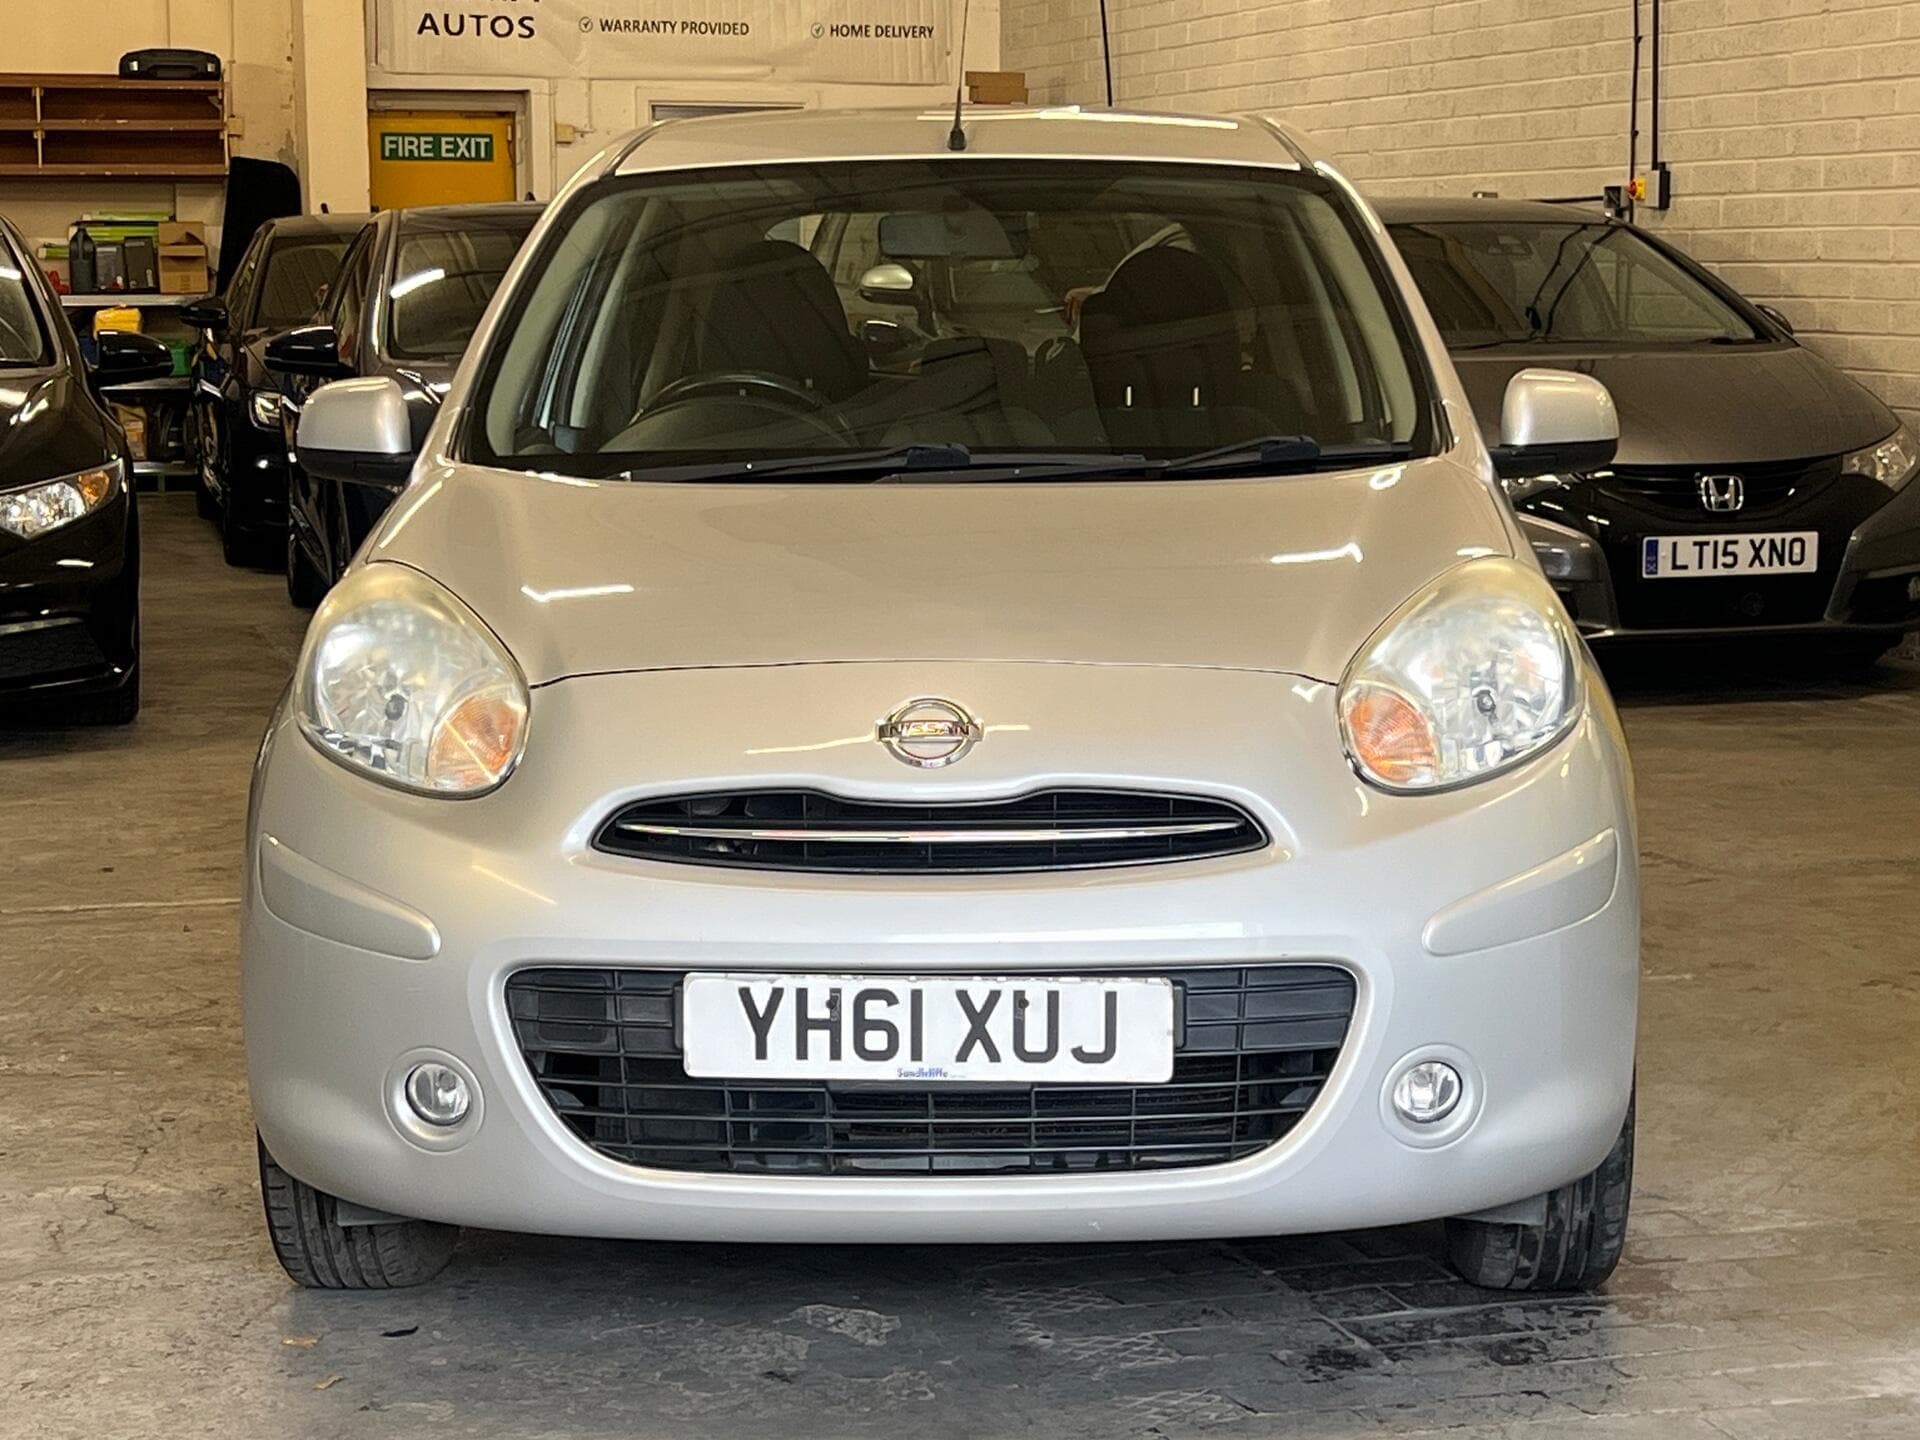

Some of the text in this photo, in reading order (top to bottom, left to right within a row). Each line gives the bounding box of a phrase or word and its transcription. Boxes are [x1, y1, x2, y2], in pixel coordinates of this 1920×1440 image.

[417, 12, 535, 39] AUTOS
[600, 18, 749, 36] WARRANTY PROVIDED
[830, 24, 934, 39] HOME DELIVERY
[384, 135, 490, 159] FIRE EXIT
[1671, 540, 1739, 570] LT15
[1748, 537, 1805, 568] XNO
[738, 987, 1117, 1064] YH61 XUJ
